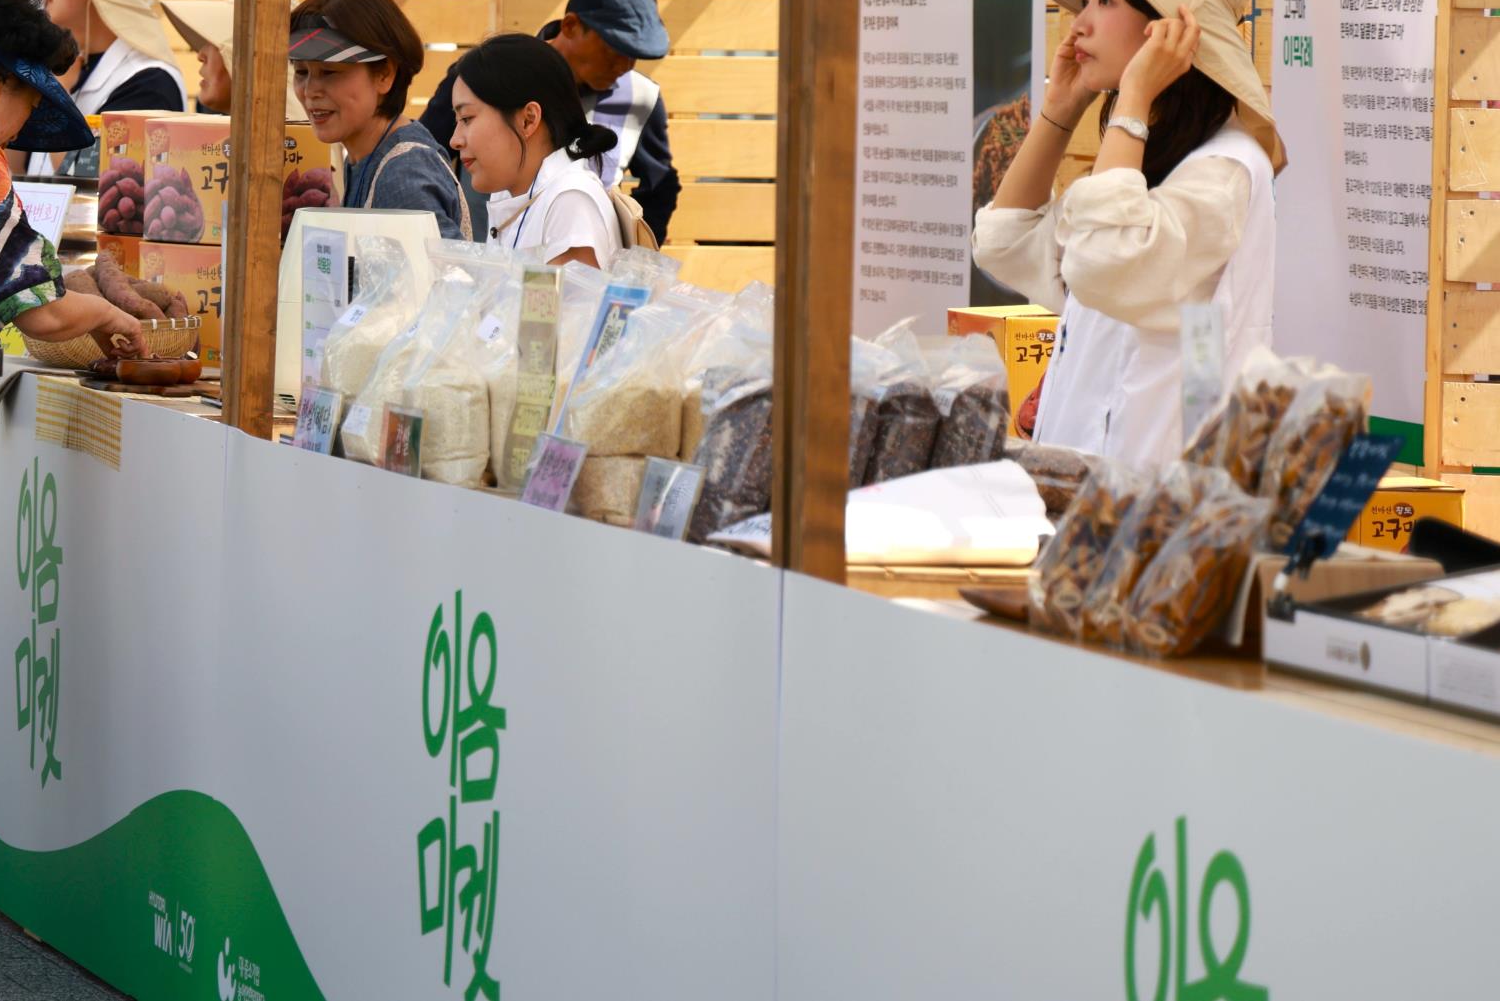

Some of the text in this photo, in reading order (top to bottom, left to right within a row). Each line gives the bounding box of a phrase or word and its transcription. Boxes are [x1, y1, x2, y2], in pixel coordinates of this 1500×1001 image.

[1283, 35, 1313, 68] 이막례
[200, 162, 229, 195] 고구
[17, 456, 64, 624] 이음
[14, 618, 62, 790] 마켓
[421, 589, 507, 804] 이음
[417, 795, 501, 1001] 마켓
